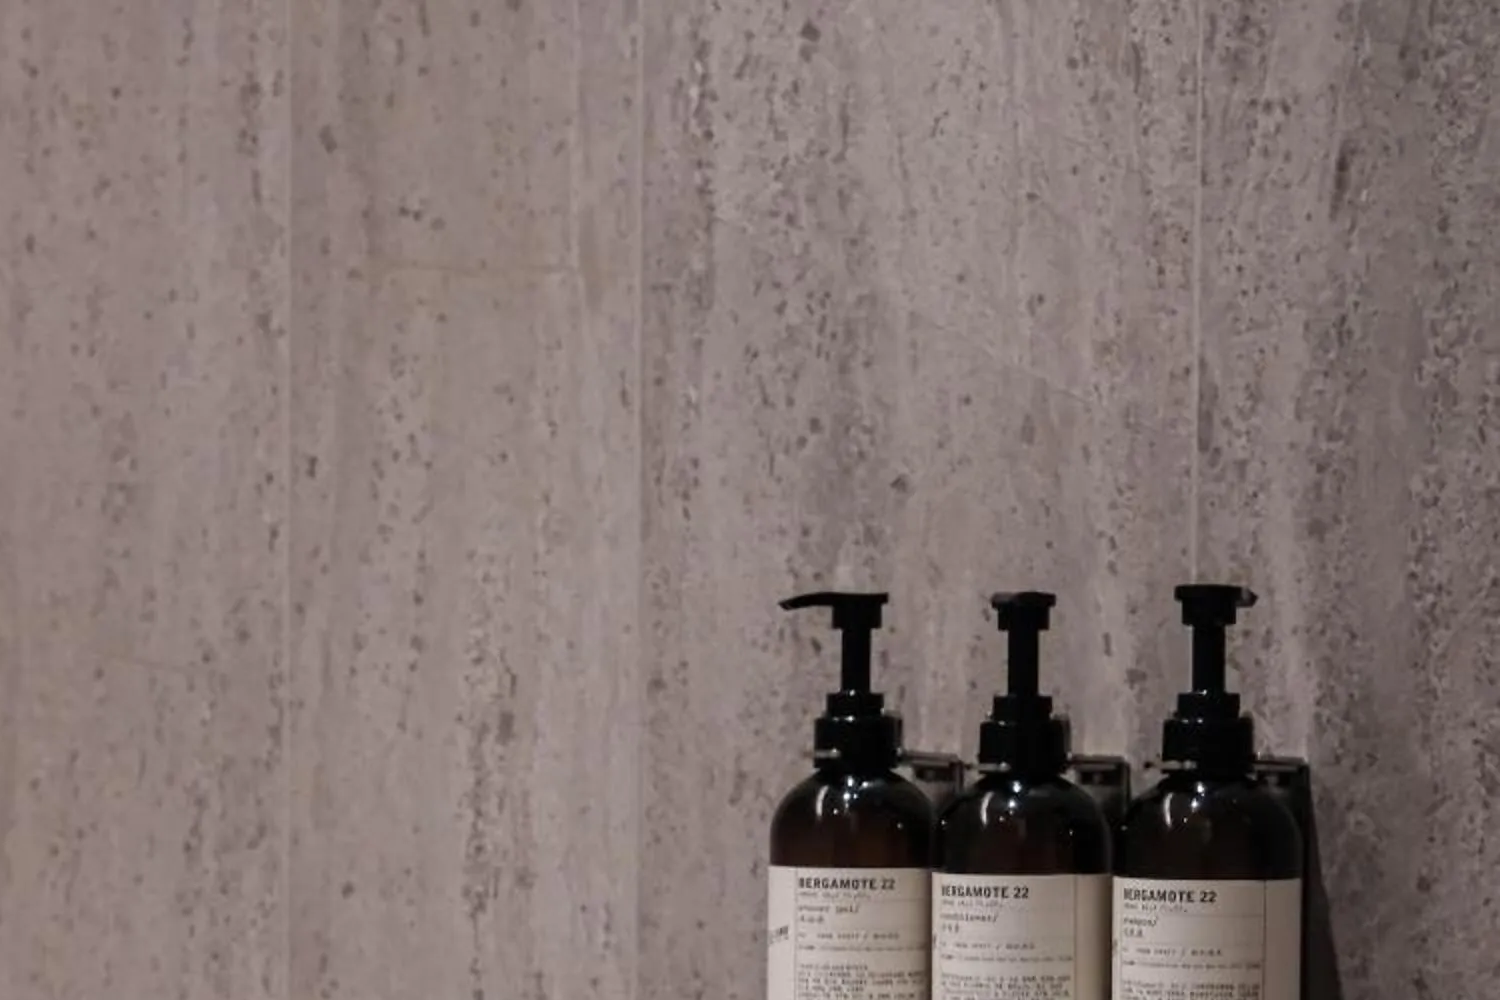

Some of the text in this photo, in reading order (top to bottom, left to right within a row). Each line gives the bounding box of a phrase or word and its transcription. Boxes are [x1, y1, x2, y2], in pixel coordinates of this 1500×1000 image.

[799, 877, 896, 891] BERGAMOTE 22
[941, 884, 1030, 899] BERGAMOTE 22
[1123, 887, 1218, 904] BERGAMOTE 22
